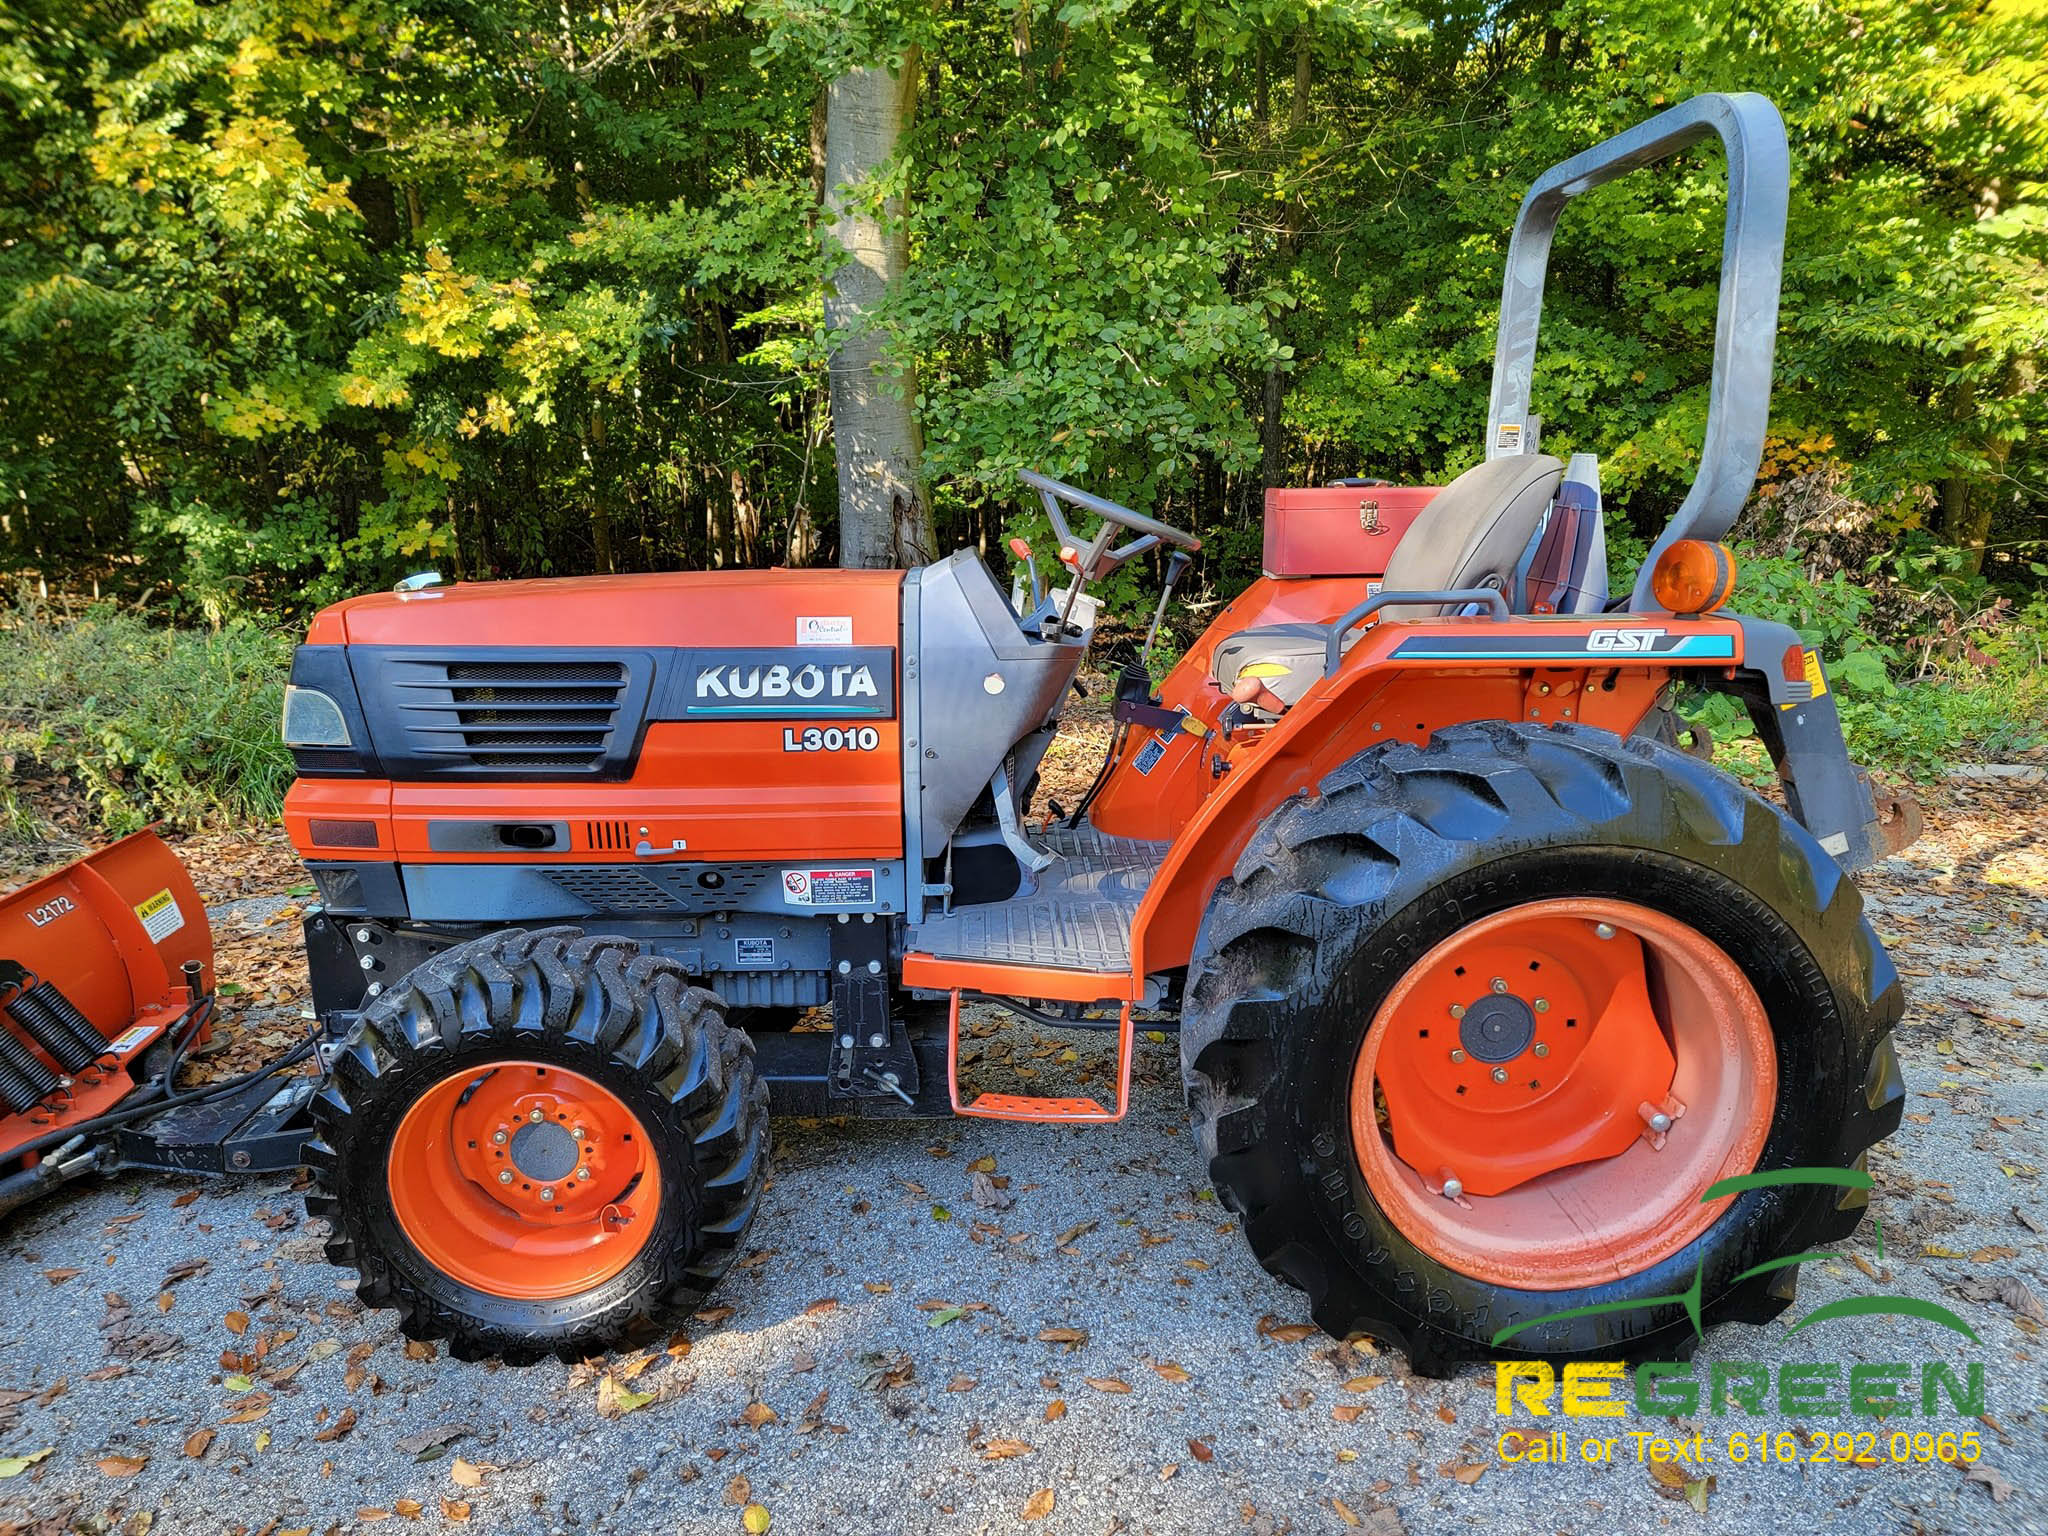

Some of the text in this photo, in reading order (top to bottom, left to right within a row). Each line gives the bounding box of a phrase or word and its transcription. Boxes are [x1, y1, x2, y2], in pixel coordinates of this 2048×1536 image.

[1586, 628, 1667, 651] GST
[695, 664, 879, 699] KUBOTA
[783, 727, 880, 752] L3010
[26, 896, 74, 926] L2172
